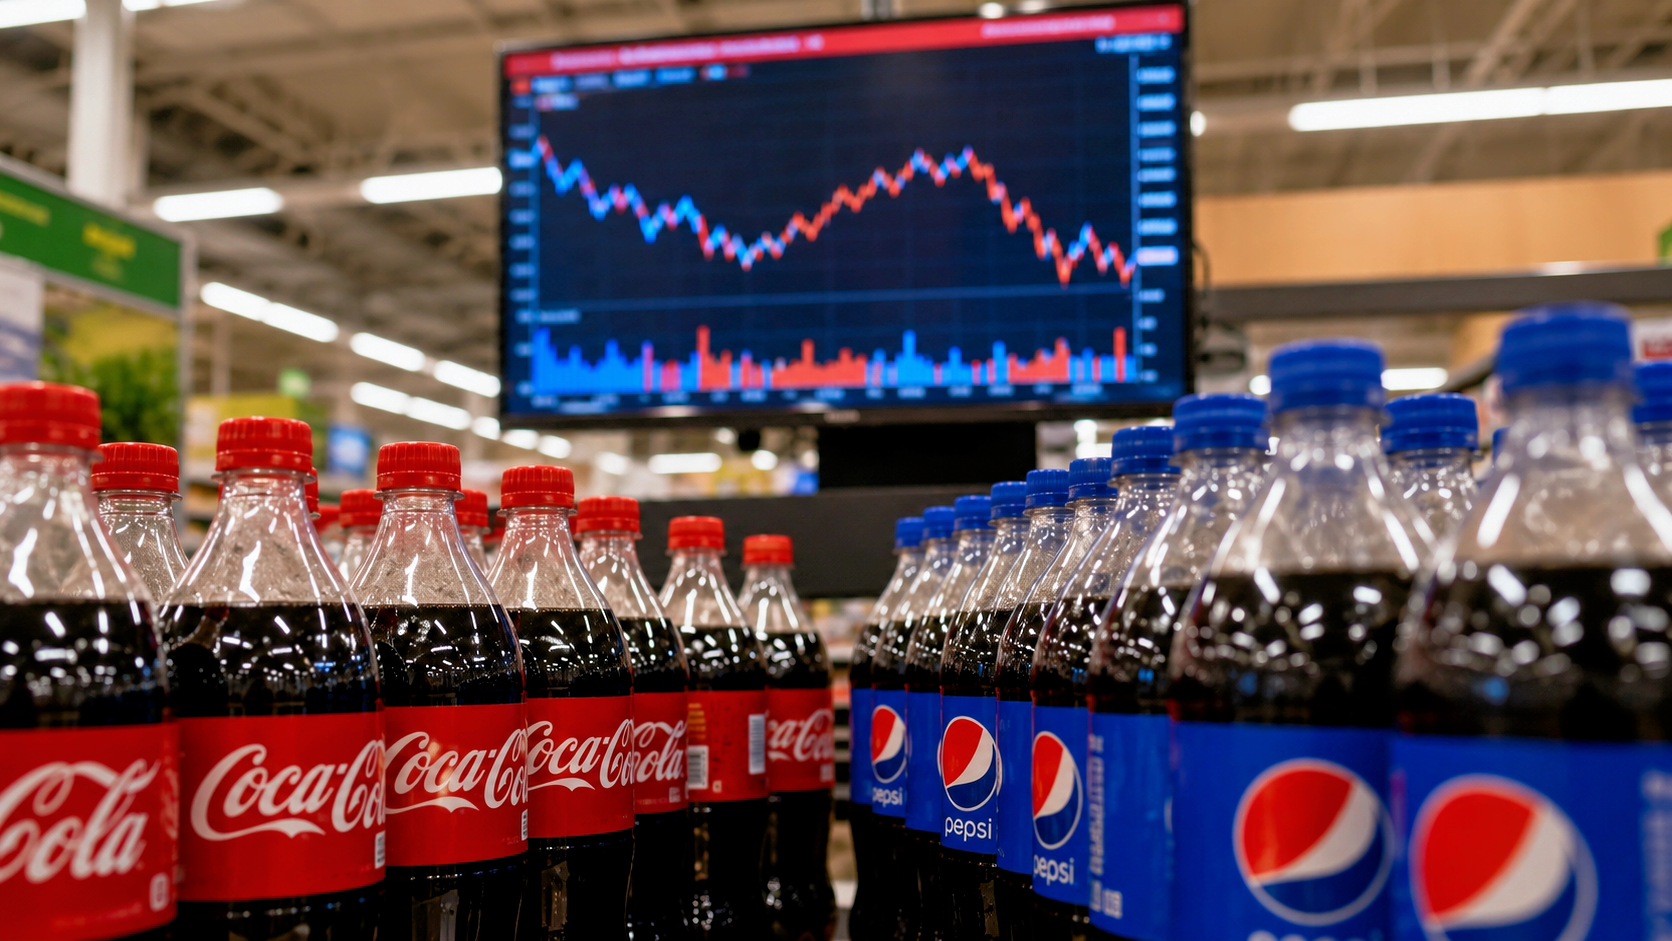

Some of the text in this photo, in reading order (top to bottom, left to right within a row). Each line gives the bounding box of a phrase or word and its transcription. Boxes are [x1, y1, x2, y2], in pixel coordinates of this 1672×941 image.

[190, 739, 386, 842] Coca-Col
[385, 728, 528, 814] Coca-Col
[527, 718, 634, 793] Coca-Col
[945, 816, 992, 842] pepsi
[1033, 854, 1075, 887] pepsi
